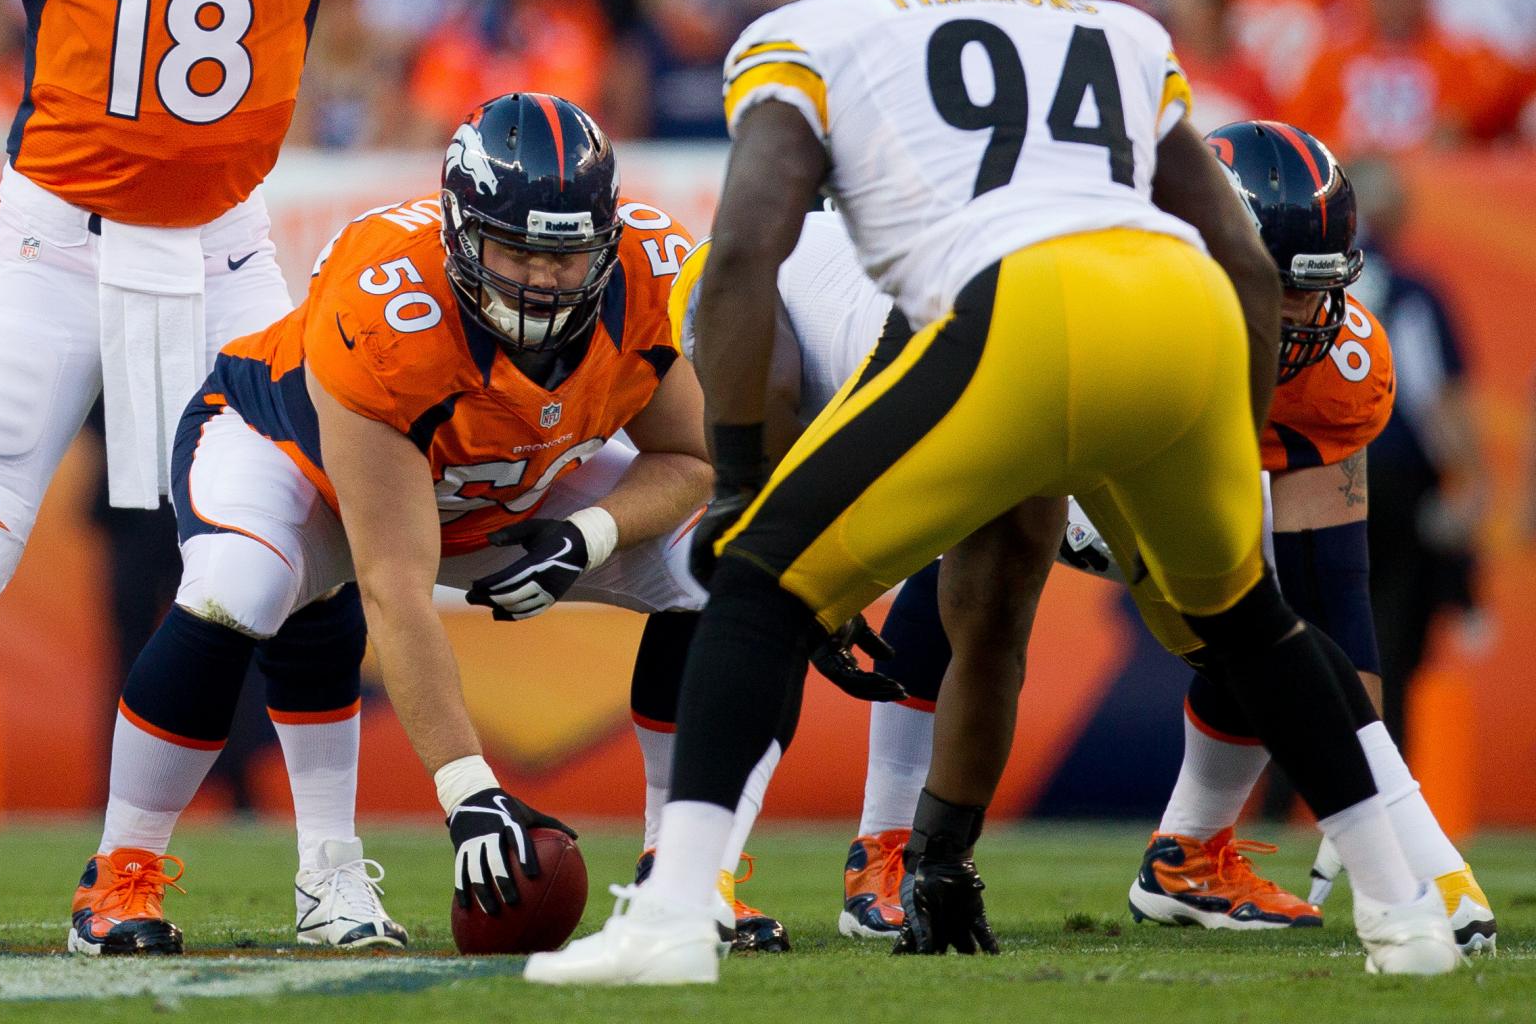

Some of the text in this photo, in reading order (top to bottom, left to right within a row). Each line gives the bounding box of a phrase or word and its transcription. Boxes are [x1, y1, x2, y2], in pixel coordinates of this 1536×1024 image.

[927, 18, 1136, 200] 94
[545, 221, 579, 232] Riddell
[617, 202, 695, 277] 50
[1307, 260, 1335, 269] Riddell
[358, 256, 442, 333] 50
[512, 433, 574, 454] BRONCOS
